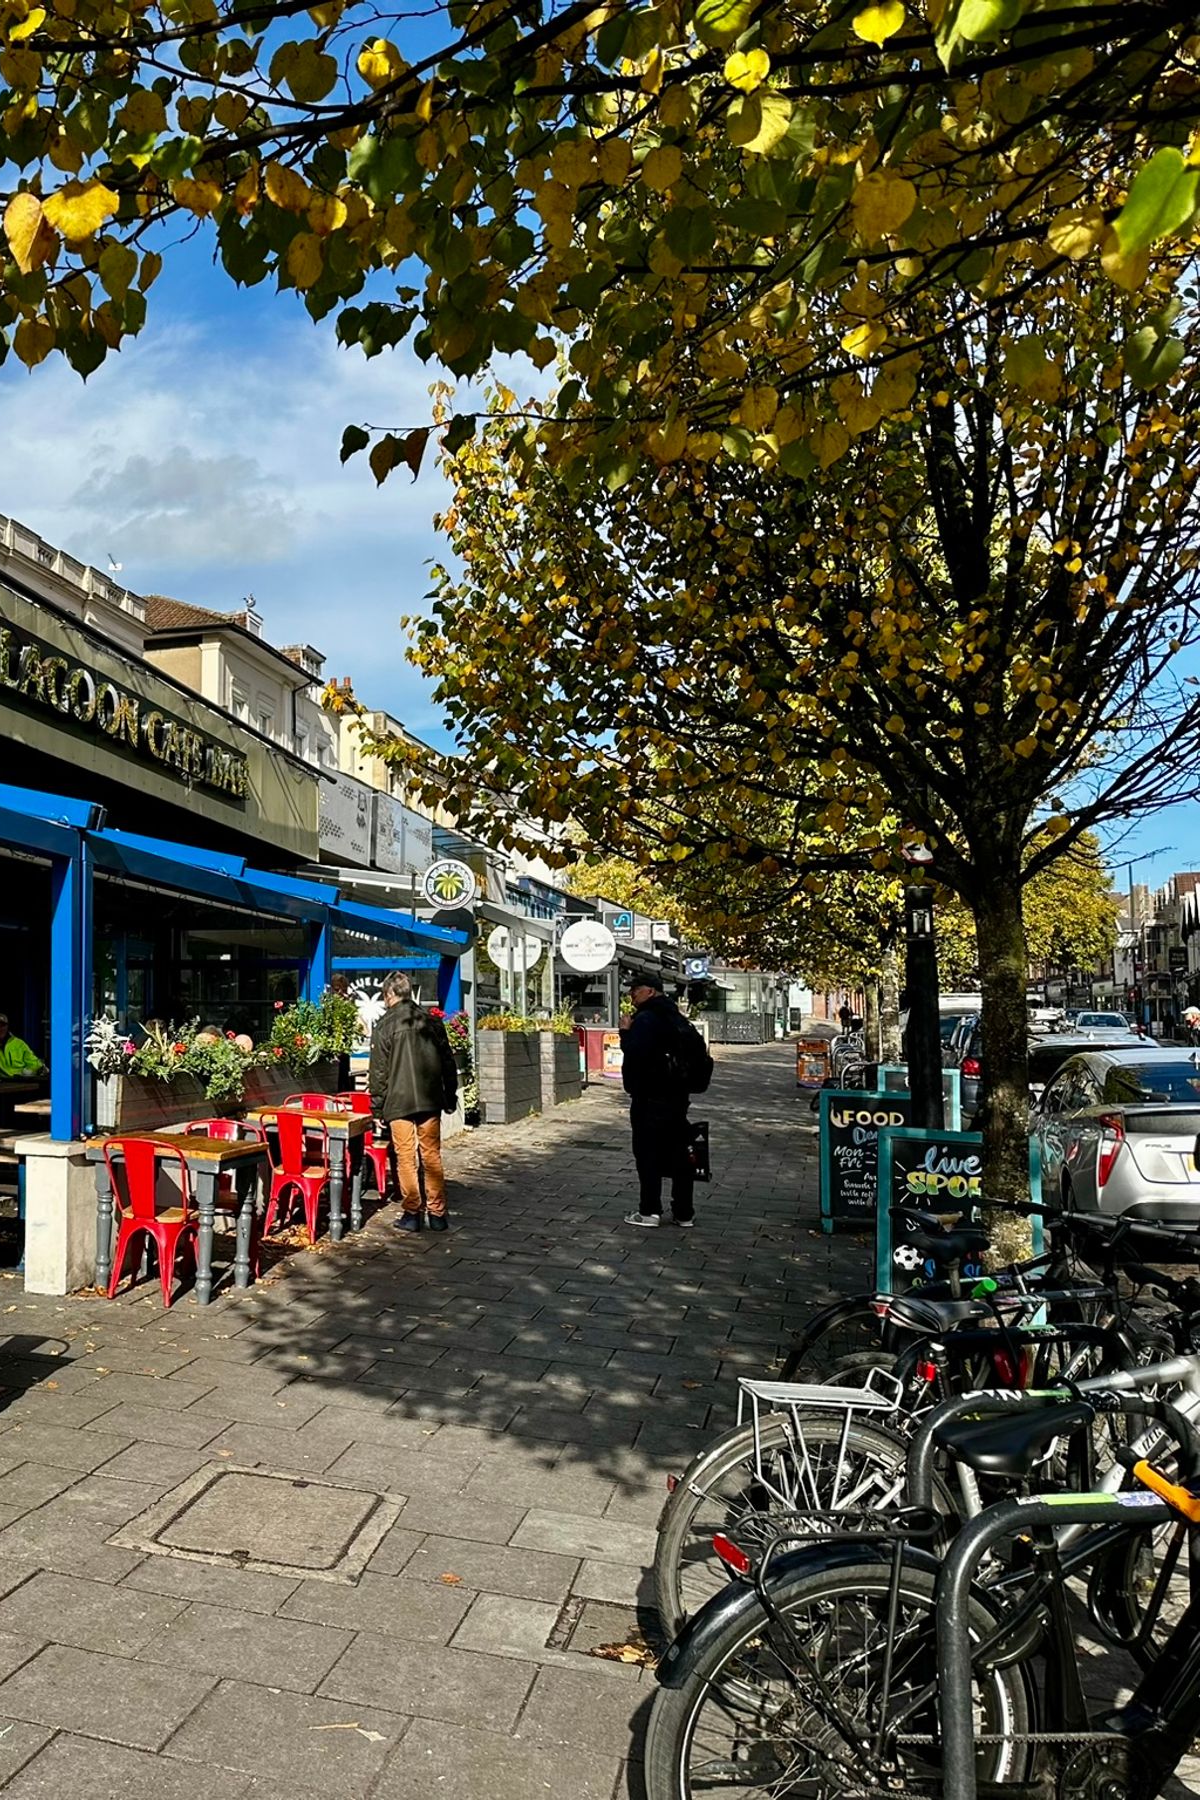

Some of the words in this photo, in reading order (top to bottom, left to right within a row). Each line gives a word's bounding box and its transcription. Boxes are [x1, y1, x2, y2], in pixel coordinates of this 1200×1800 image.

[842, 1110, 905, 1127] FOOD
[834, 1145, 864, 1157] Mon
[916, 1145, 982, 1175] live
